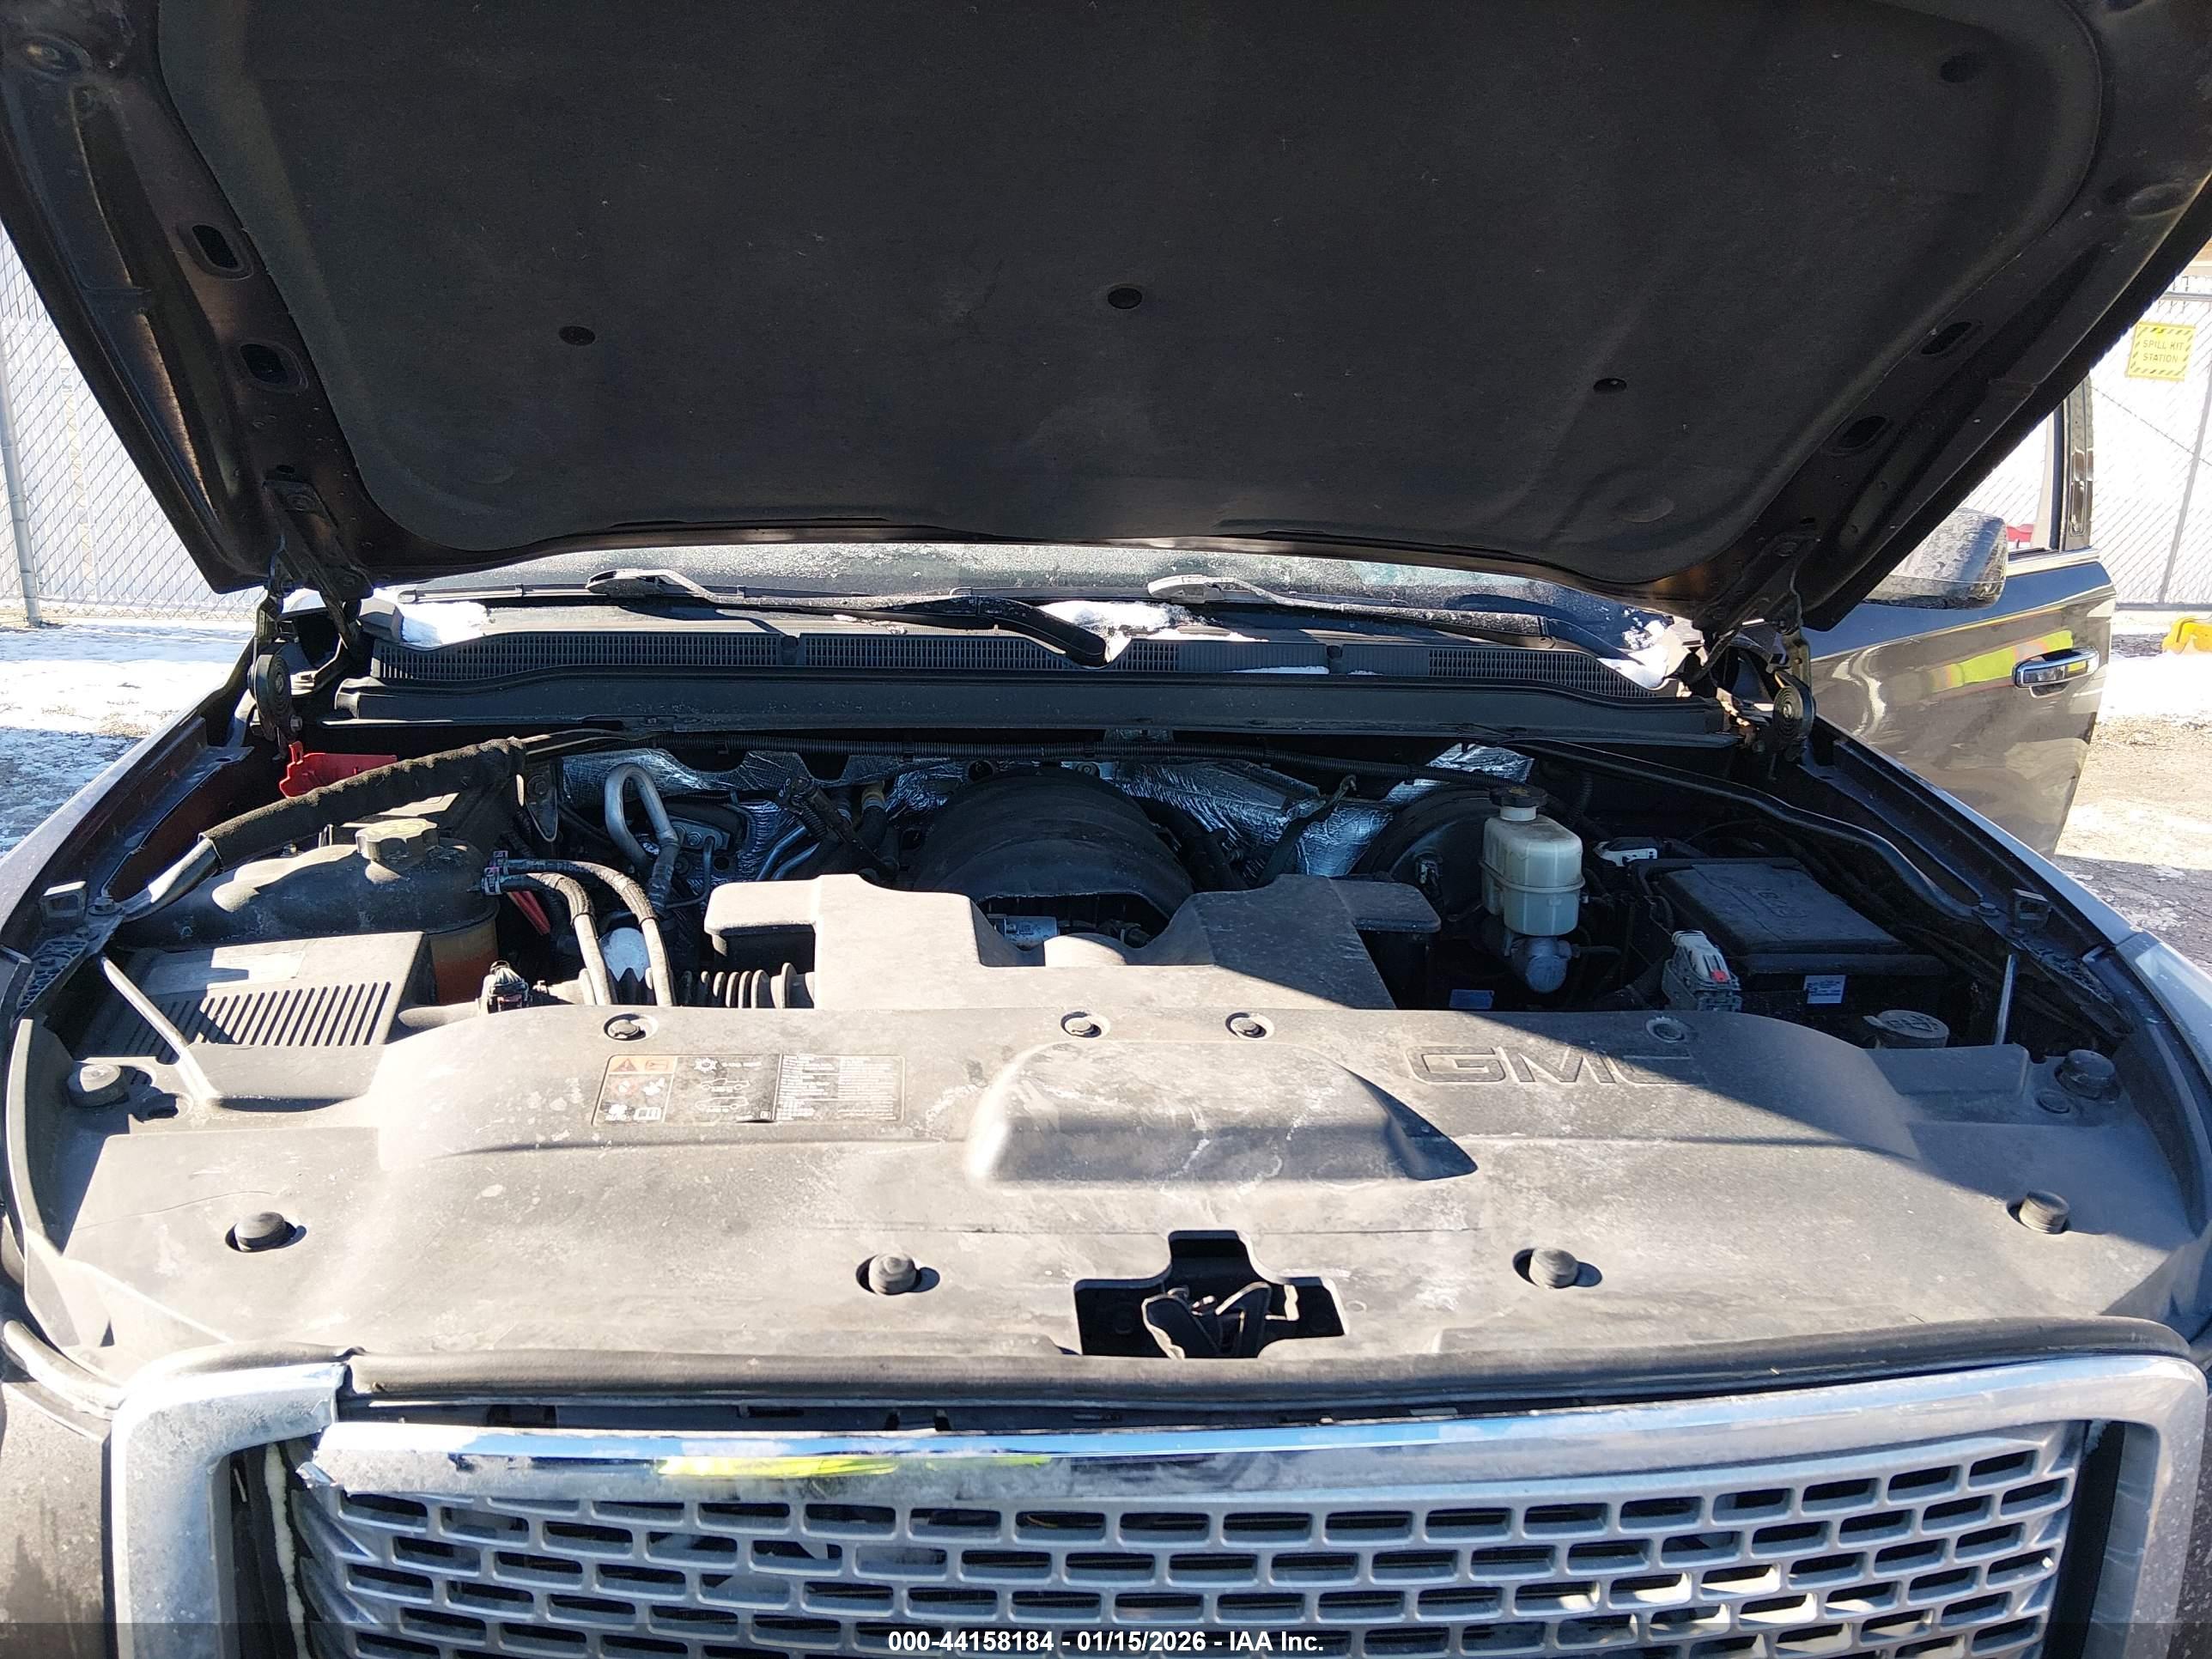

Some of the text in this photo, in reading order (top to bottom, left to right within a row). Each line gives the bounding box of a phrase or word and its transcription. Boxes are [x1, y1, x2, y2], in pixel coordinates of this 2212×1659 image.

[2142, 339, 2185, 351] SPILL KIT
[2142, 353, 2179, 363] STATION
[1406, 1045, 1698, 1085] GMC
